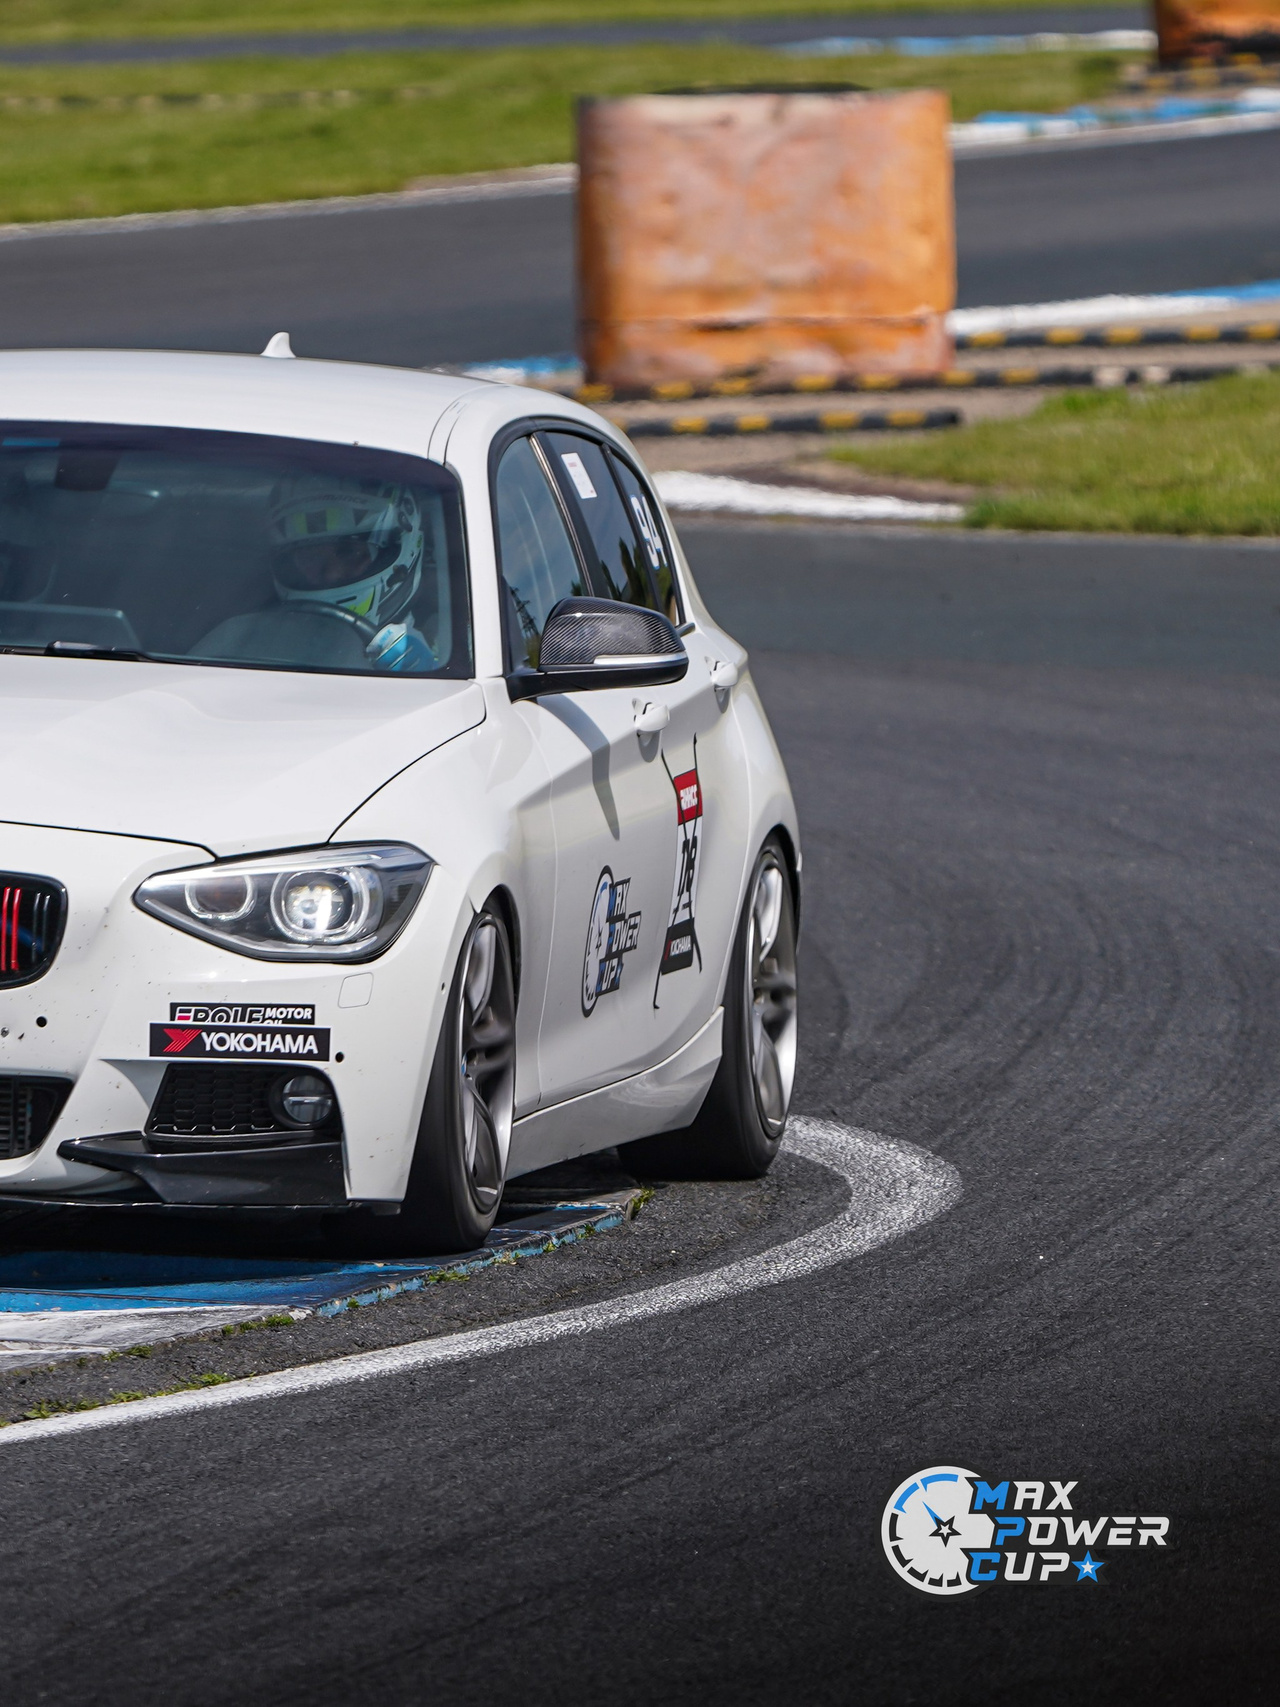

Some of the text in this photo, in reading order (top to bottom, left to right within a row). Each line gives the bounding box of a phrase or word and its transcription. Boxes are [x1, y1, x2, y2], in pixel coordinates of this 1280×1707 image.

[630, 494, 668, 570] 94
[264, 1007, 312, 1020] MOTOR
[200, 1031, 319, 1055] YOKOHAMA
